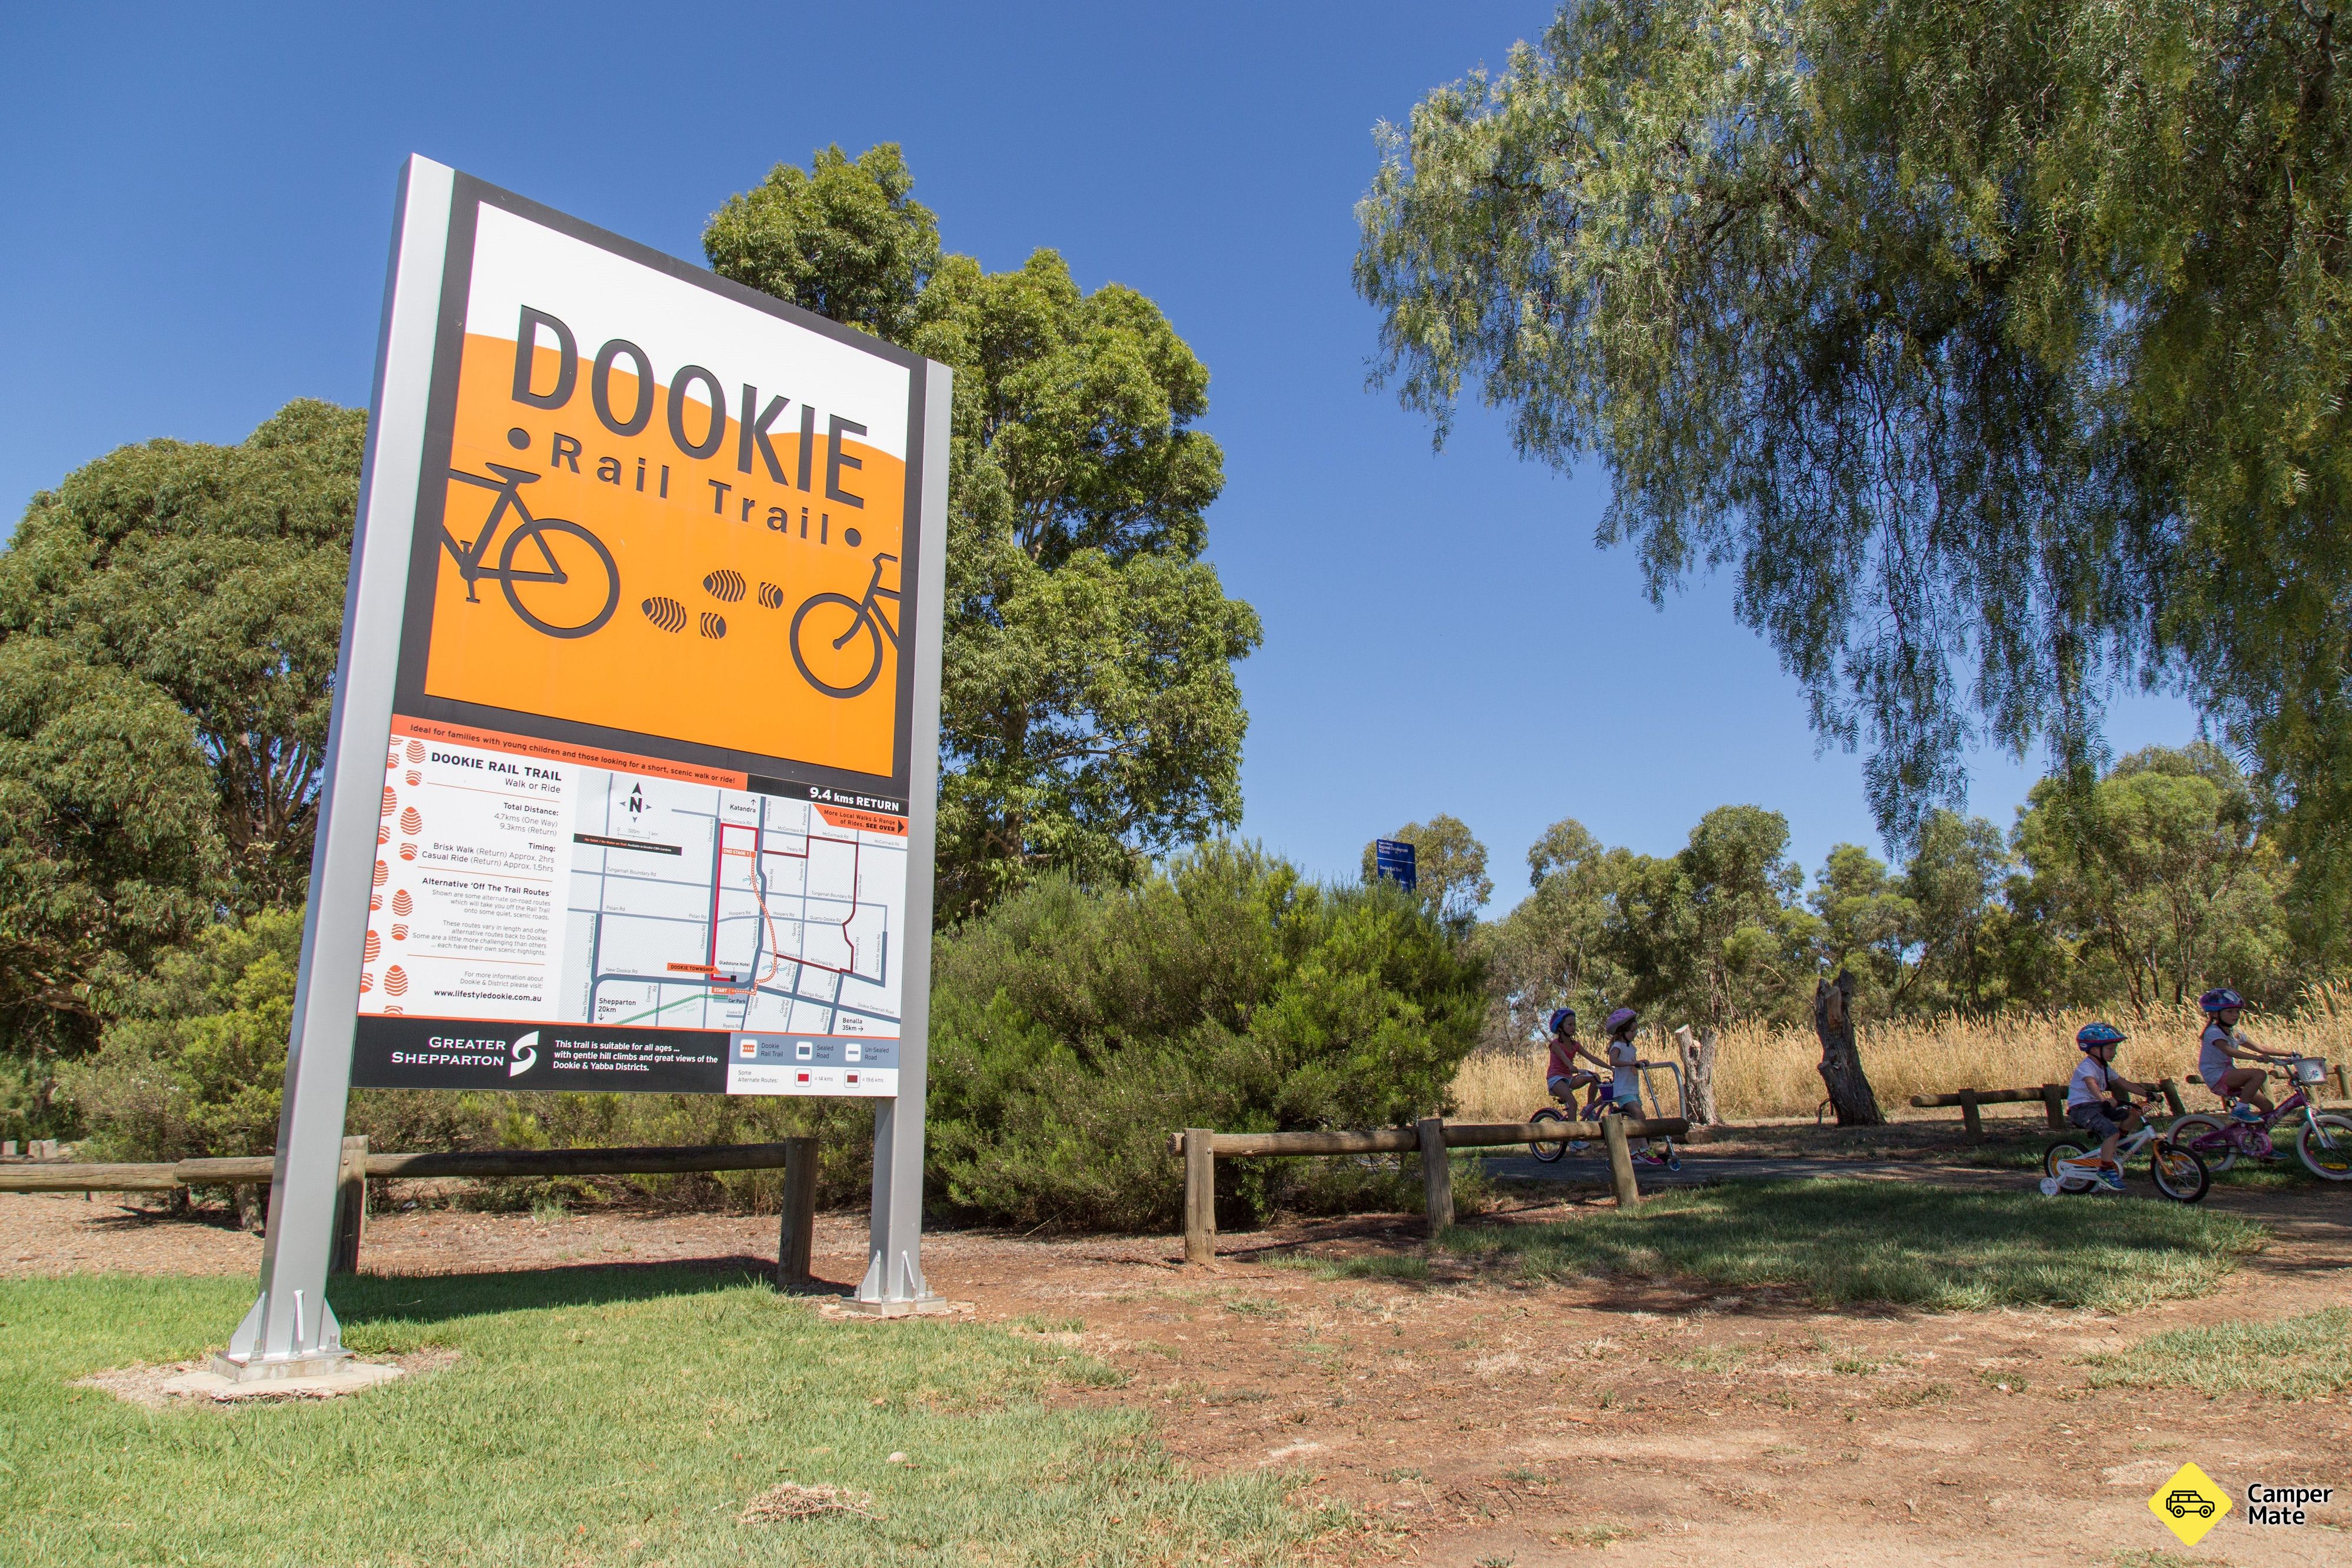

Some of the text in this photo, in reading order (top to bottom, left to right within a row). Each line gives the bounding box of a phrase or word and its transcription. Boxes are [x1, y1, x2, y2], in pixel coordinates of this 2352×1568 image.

[511, 304, 868, 510] DOOKIE
[550, 431, 828, 546] Rail Trail
[410, 724, 431, 734] Ideal
[433, 727, 446, 736] for
[447, 730, 480, 742] families
[483, 737, 500, 745] with
[503, 741, 527, 751] young
[529, 745, 560, 755] children
[578, 752, 599, 762] those
[601, 756, 627, 768] looking
[647, 764, 669, 773] short,
[670, 769, 693, 777] scenic
[720, 776, 735, 784] ride!
[431, 752, 562, 782] DOOKIE RAIL TRAIL
[505, 778, 526, 788] Walk
[541, 783, 561, 793] Ride
[629, 796, 642, 813] N
[809, 786, 899, 812] 9.4 kms RETURN
[503, 802, 559, 816] Total Distance:
[730, 804, 756, 813] Katandra
[494, 813, 558, 828] 4.7kms (One Way)
[848, 819, 864, 828] Rides.
[879, 818, 895, 826] Range
[500, 822, 557, 836] 9.3kms (Return)
[433, 842, 554, 863] Brisk Walk (Return) Approx. 2hrs
[528, 842, 556, 853] Timing:
[421, 851, 554, 872] Casual Ride (Return) Approx. 1.5hrs
[422, 877, 469, 888] Alternative
[504, 885, 521, 893] Trail
[451, 928, 484, 936] alternative
[434, 990, 542, 1002] www.lifestyledookie.com.au
[599, 997, 636, 1006] Shepparton
[428, 1037, 506, 1051] GREATER
[555, 1039, 672, 1053] This trail is suitable for all ages
[391, 1051, 504, 1066] SHEPPARTON
[554, 1050, 572, 1058] with
[573, 1051, 598, 1060] gentle
[613, 1052, 637, 1061] climbs
[654, 1054, 675, 1063] great
[675, 1054, 696, 1062] views
[553, 1061, 581, 1069] Dookie
[590, 1062, 614, 1070] Yabba
[615, 1062, 650, 1071] Districts.
